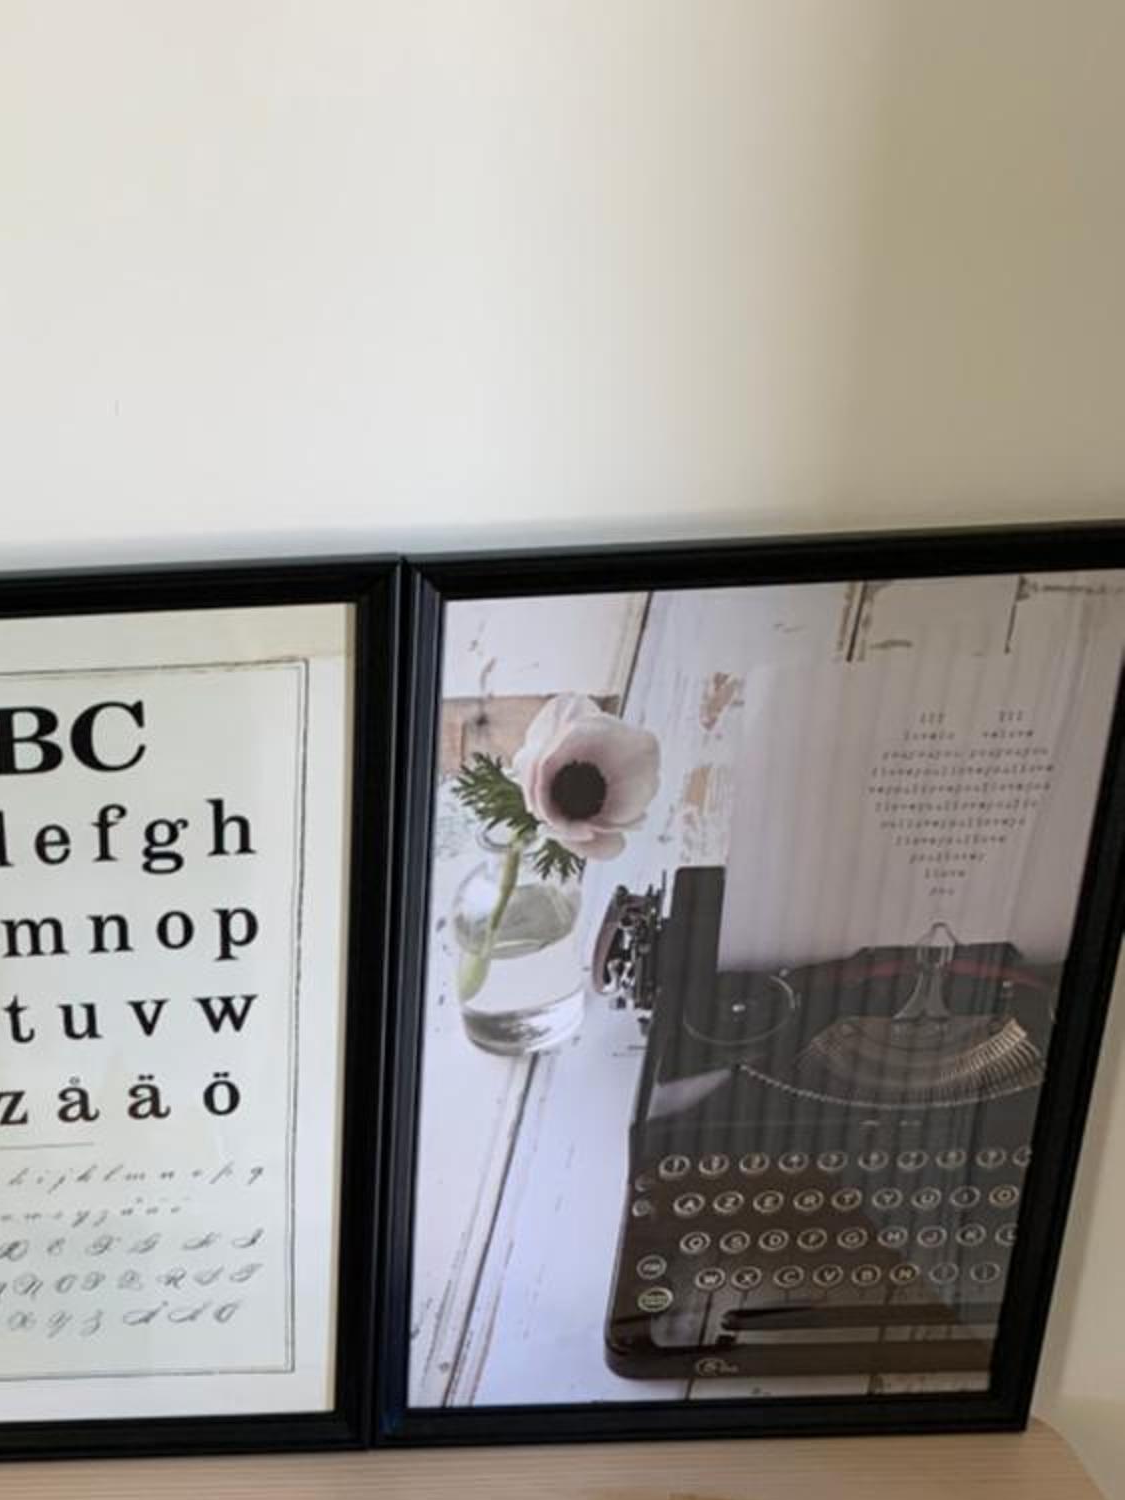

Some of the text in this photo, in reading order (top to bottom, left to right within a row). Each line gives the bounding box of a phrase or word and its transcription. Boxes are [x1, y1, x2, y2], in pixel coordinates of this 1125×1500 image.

[34, 824, 71, 866] e
[92, 803, 127, 862] f
[141, 818, 189, 875] g
[207, 798, 255, 857] h
[0, 917, 68, 958] m
[88, 914, 133, 954] n
[156, 910, 195, 950] o
[214, 907, 259, 961] p
[3, 996, 35, 1044] t
[58, 1002, 101, 1040] u
[128, 999, 167, 1037] v
[195, 994, 257, 1033] w
[57, 1075, 100, 1123] å
[127, 1073, 171, 1120] ä
[203, 1071, 241, 1116] ö
